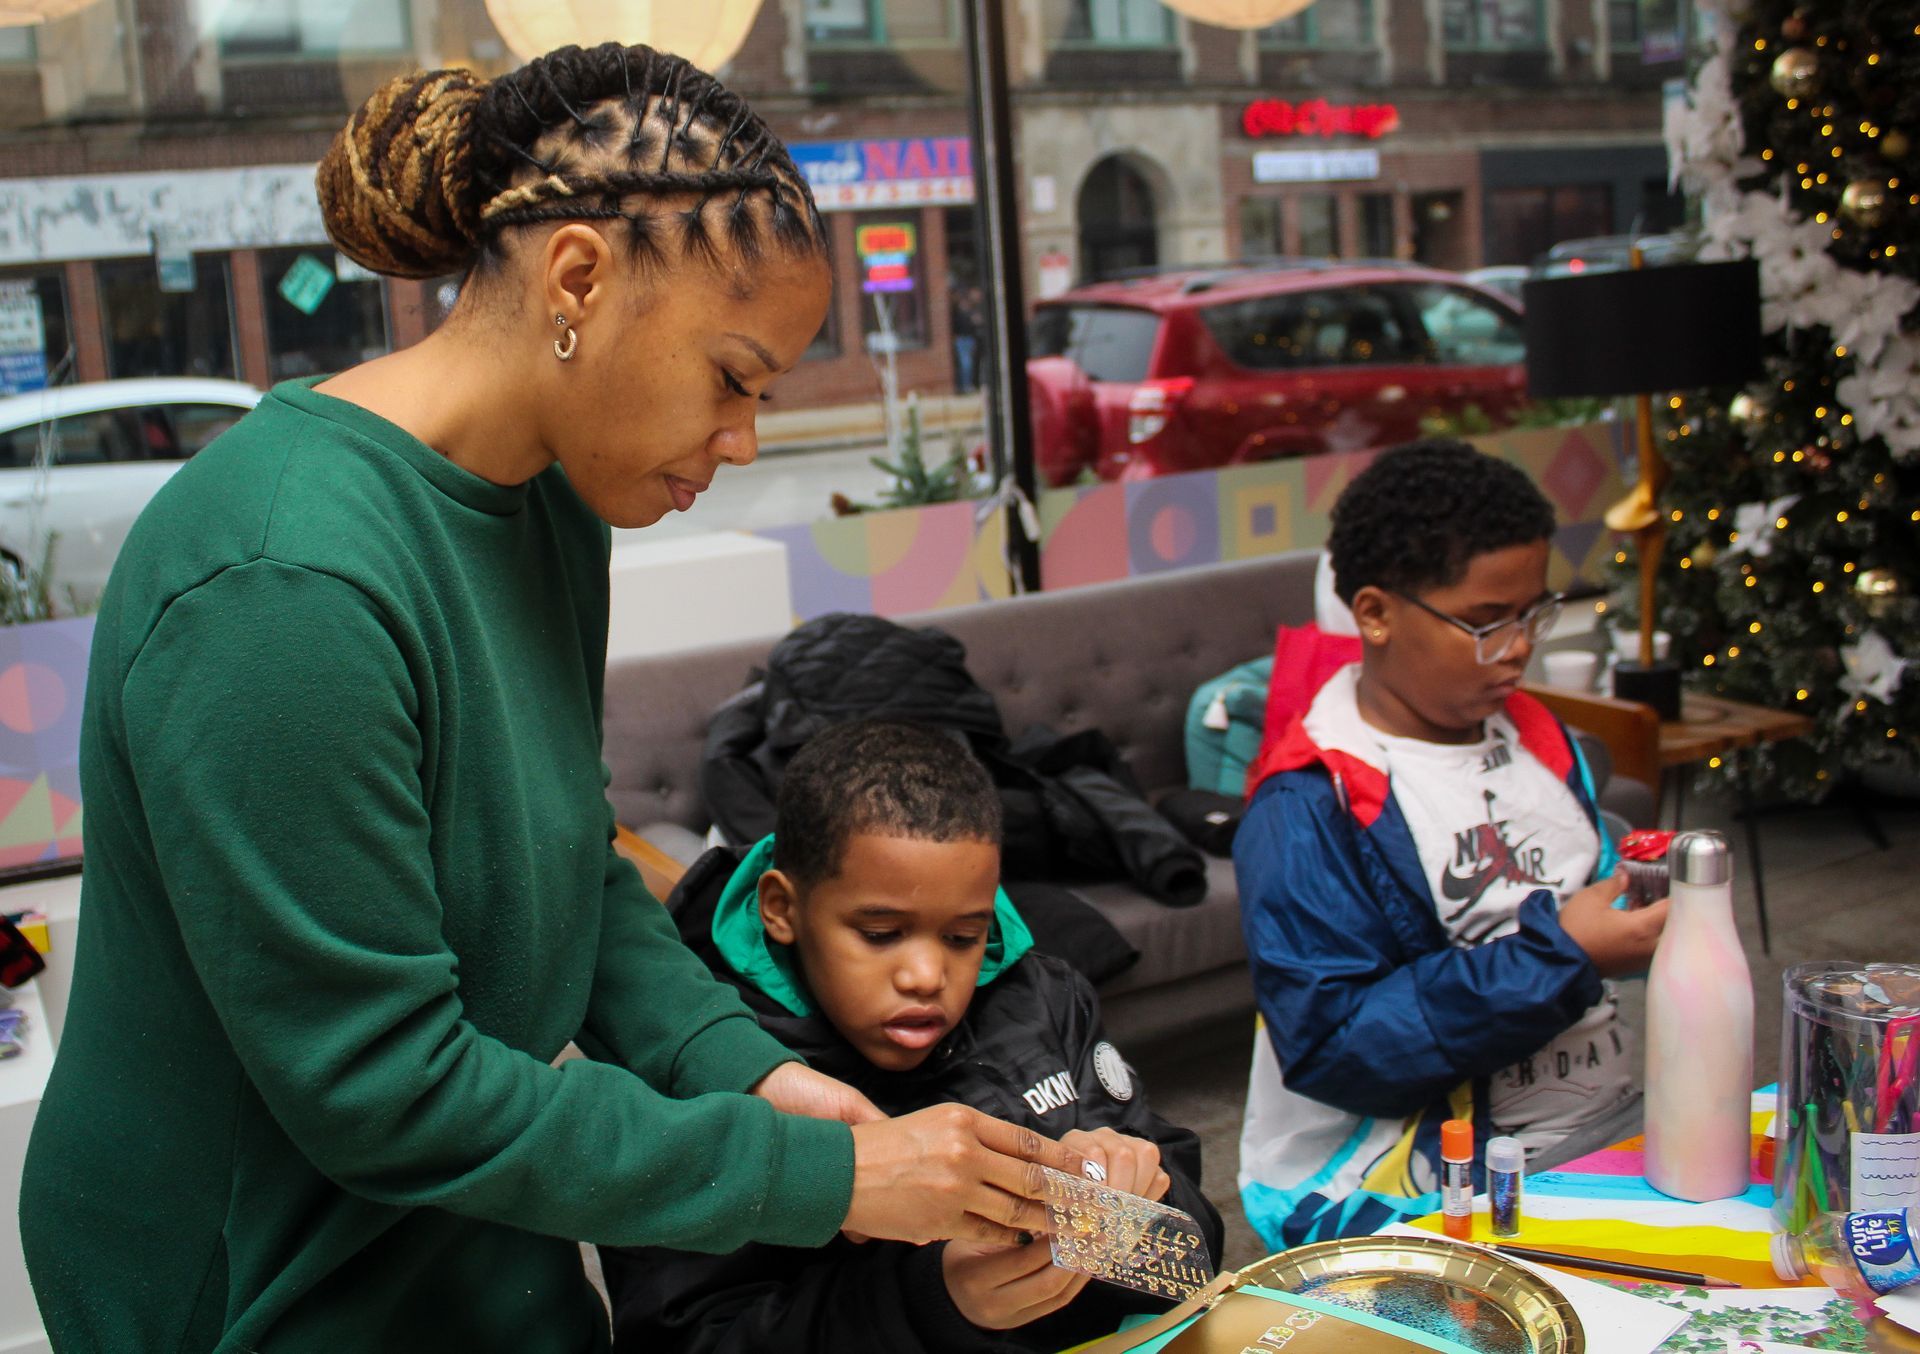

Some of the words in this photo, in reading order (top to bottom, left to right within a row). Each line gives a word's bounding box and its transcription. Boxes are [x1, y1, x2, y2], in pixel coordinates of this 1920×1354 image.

[803, 160, 862, 183] TOP
[1022, 1071, 1079, 1115] DKNY
[1851, 1218, 1872, 1257] Pure
[1865, 1218, 1888, 1250] Life
